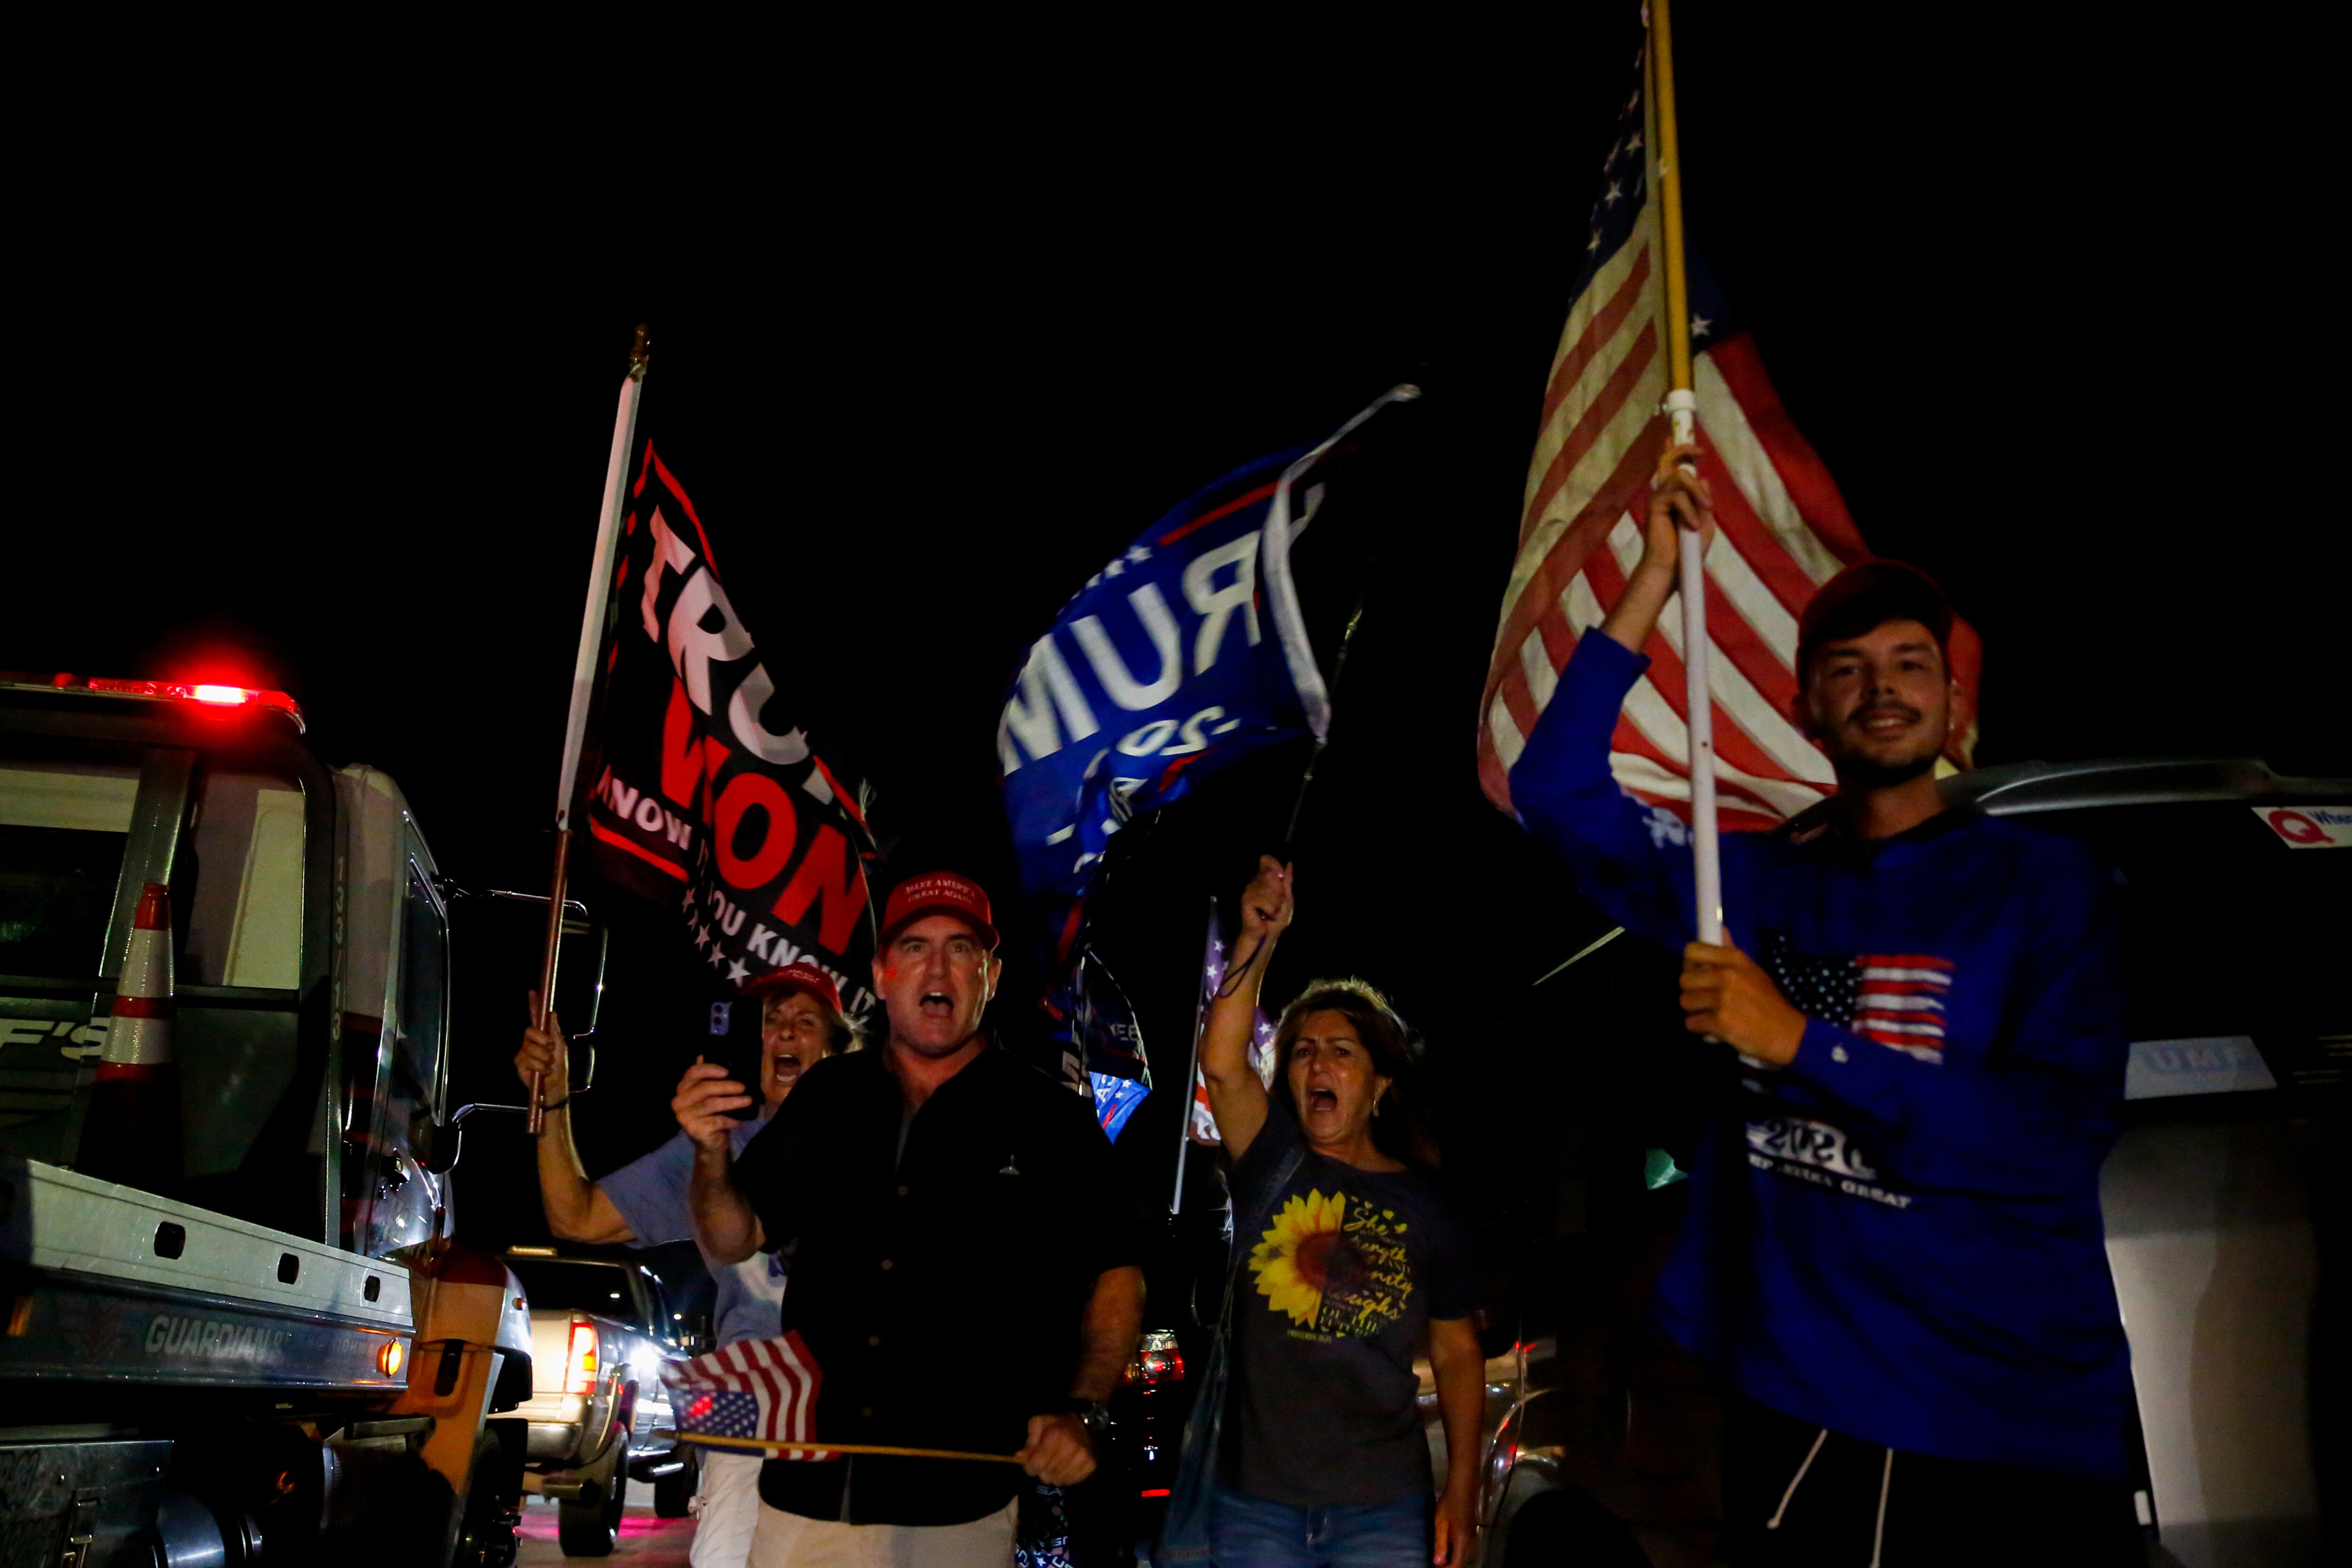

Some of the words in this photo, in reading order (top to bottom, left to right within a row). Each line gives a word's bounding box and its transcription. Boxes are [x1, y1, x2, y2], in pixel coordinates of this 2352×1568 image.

[660, 675, 868, 956] WON
[2268, 811, 2334, 843] Q
[145, 1315, 273, 1361] GUARDIAN
